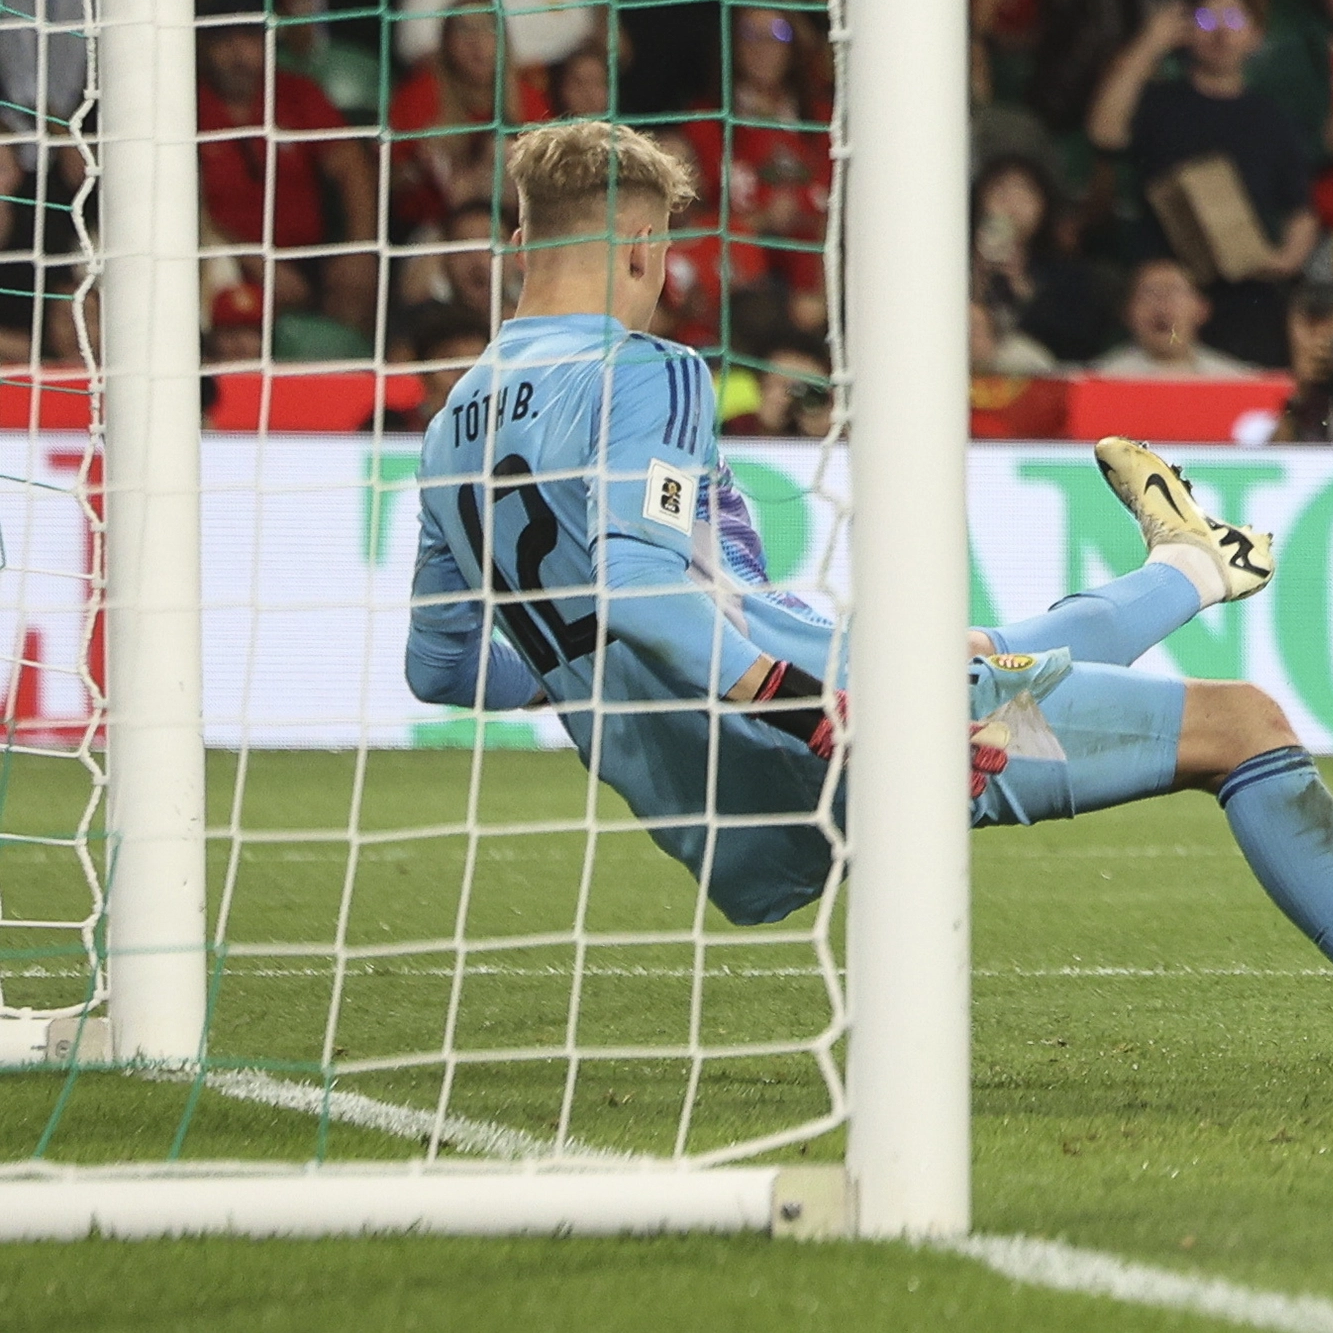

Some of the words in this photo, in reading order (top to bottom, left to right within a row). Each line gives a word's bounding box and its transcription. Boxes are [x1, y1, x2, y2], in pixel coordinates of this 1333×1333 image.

[452, 386, 509, 448] TÓTH
[511, 381, 540, 422] B.
[457, 453, 620, 677] 12
